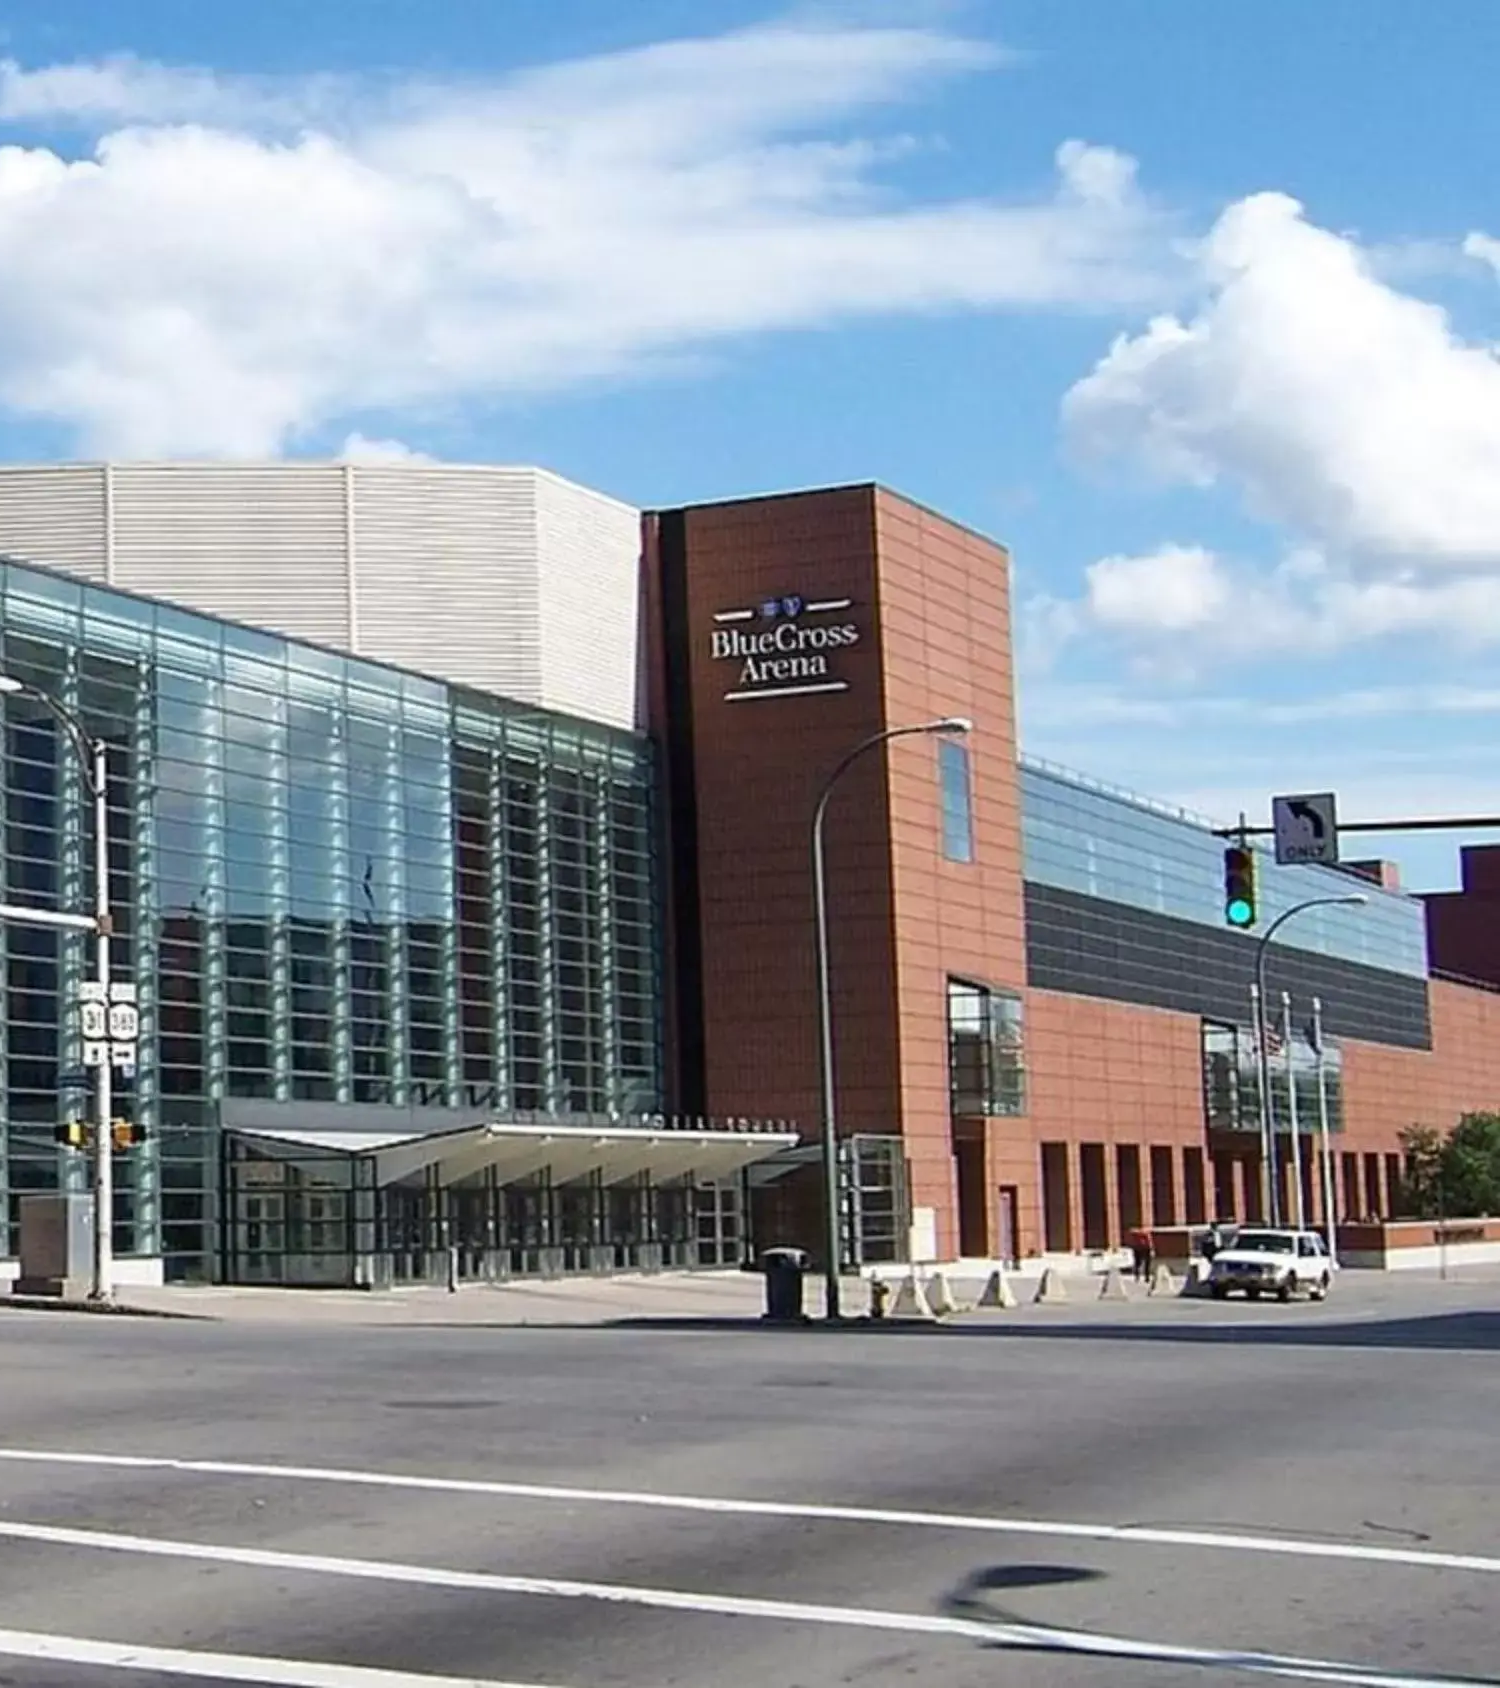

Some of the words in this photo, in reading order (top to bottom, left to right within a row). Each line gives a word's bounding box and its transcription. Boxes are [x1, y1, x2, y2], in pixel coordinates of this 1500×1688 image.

[710, 623, 860, 659] BlueCross
[739, 654, 827, 686] Arena
[1284, 844, 1327, 859] ONLY
[86, 1010, 102, 1031] 31
